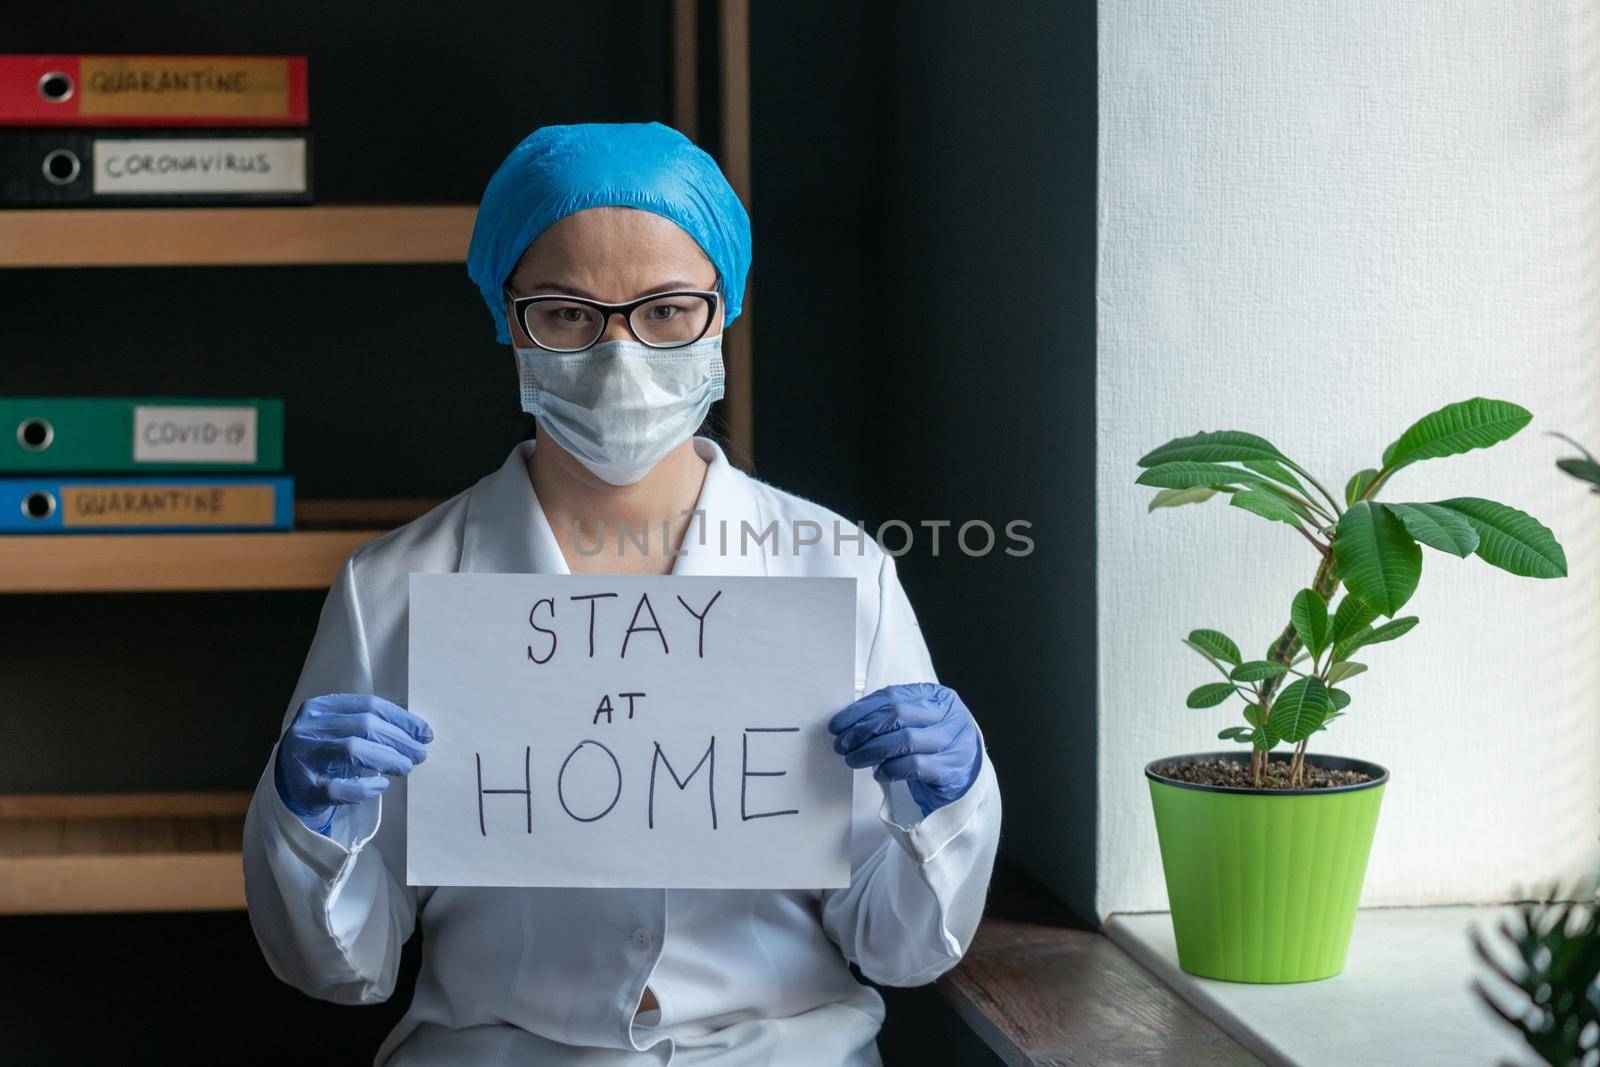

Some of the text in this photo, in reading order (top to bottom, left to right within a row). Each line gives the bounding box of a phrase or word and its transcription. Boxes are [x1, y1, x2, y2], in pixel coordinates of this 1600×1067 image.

[143, 421, 248, 447] COVID-19
[75, 489, 225, 515] QUARANTINE
[527, 590, 722, 664] STAY
[593, 692, 647, 724] AT
[475, 728, 801, 836] HOME
